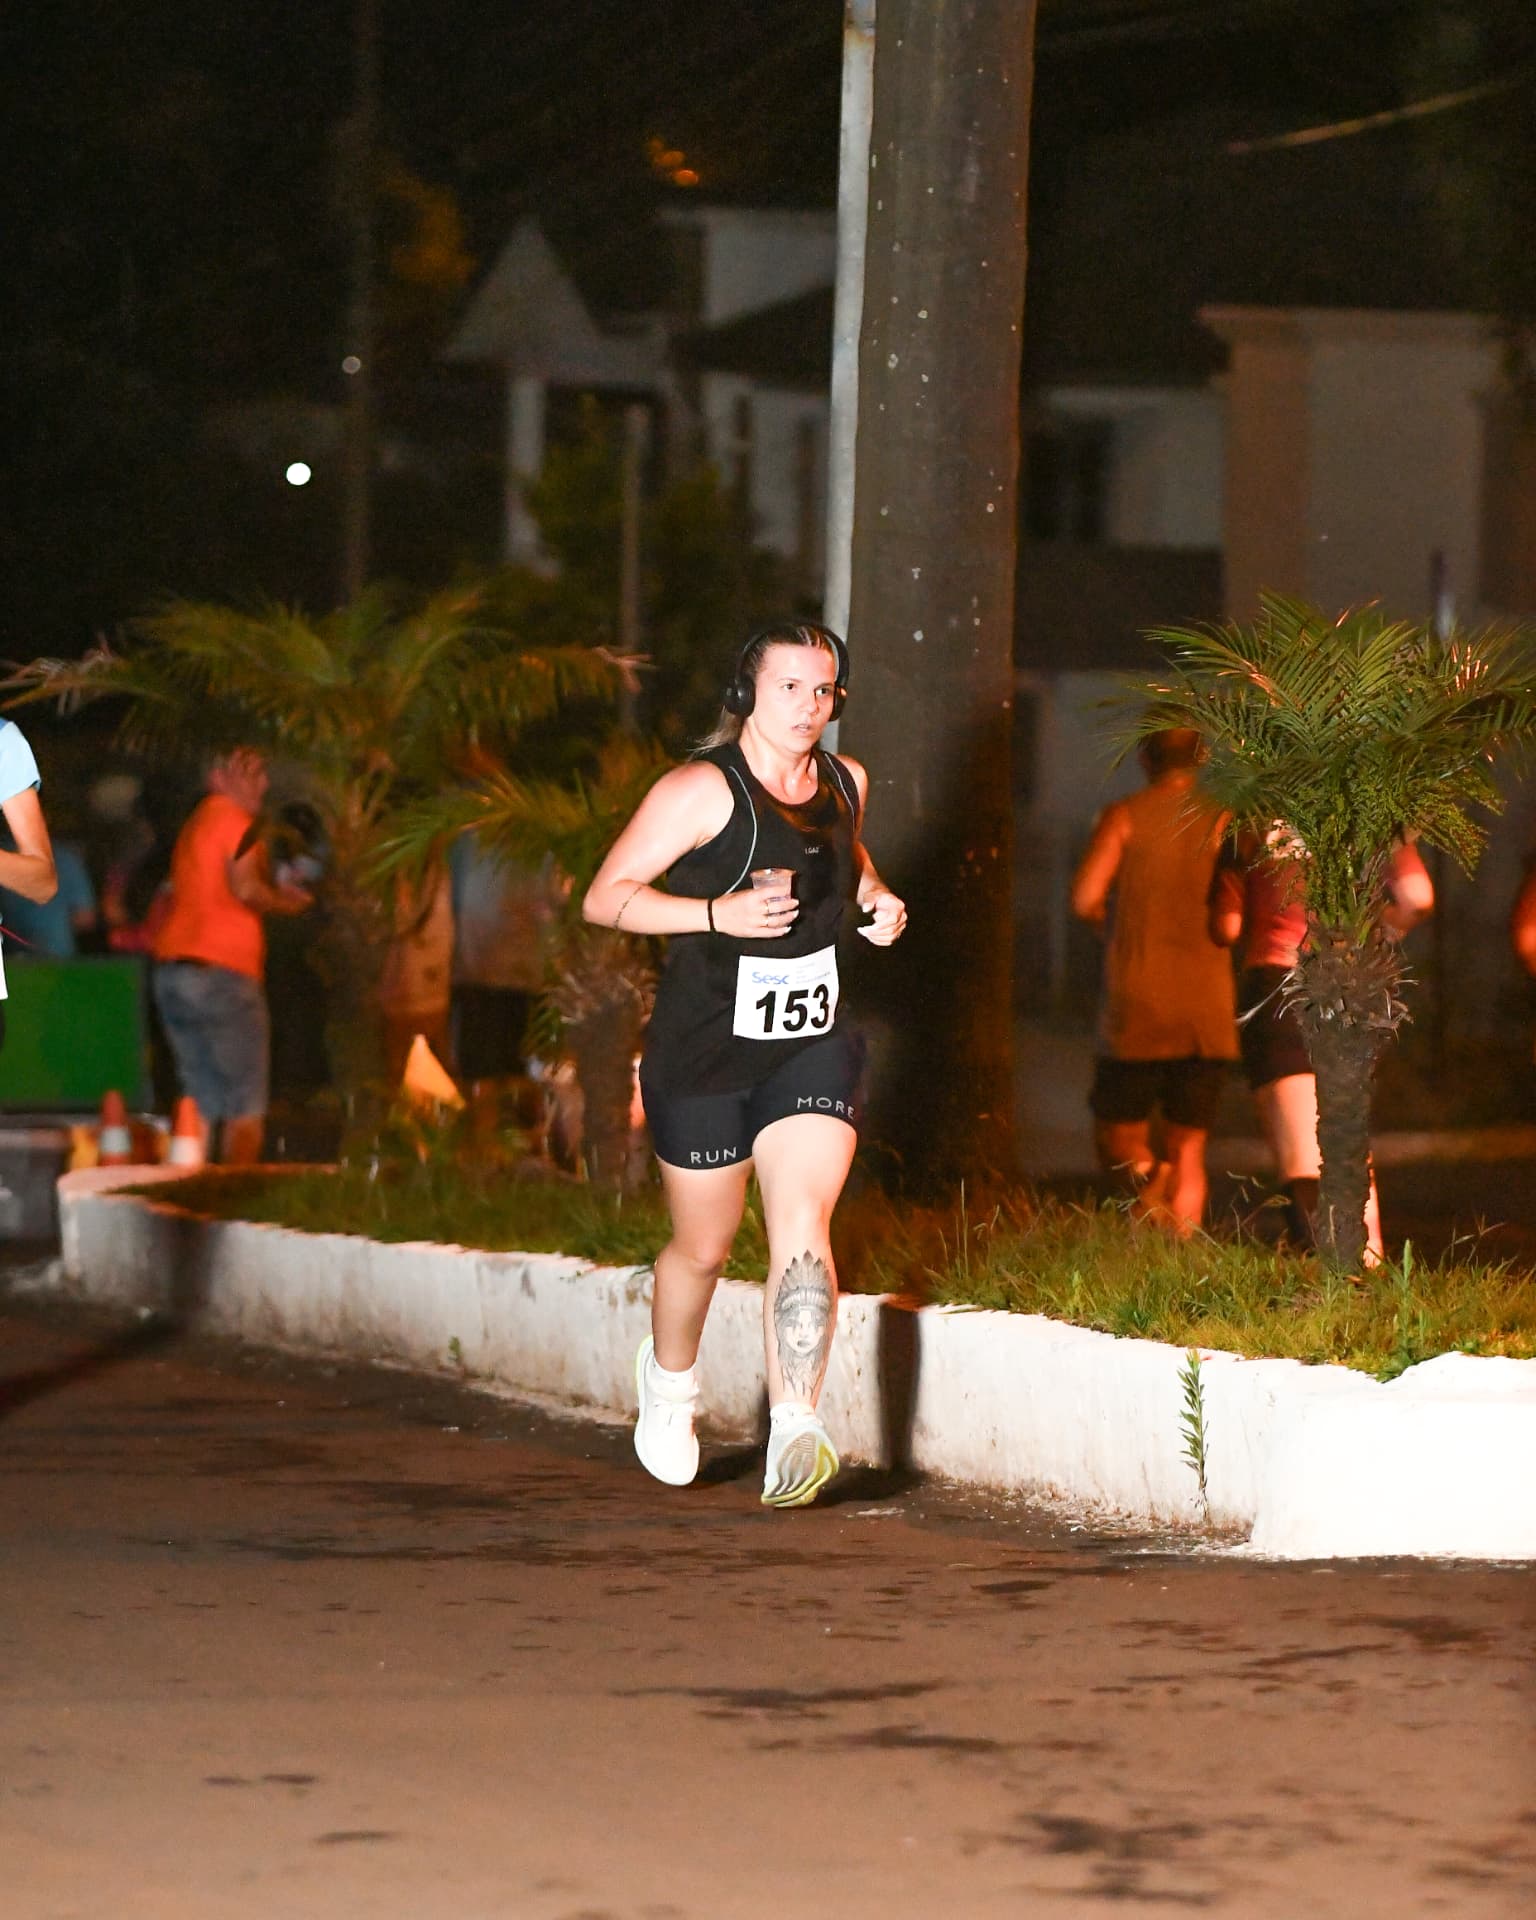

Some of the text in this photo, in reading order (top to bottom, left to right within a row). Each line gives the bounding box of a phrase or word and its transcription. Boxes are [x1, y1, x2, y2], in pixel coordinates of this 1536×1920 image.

[756, 984, 829, 1033] 153
[796, 1096, 855, 1120] MORE
[690, 1147, 737, 1164] RUN
